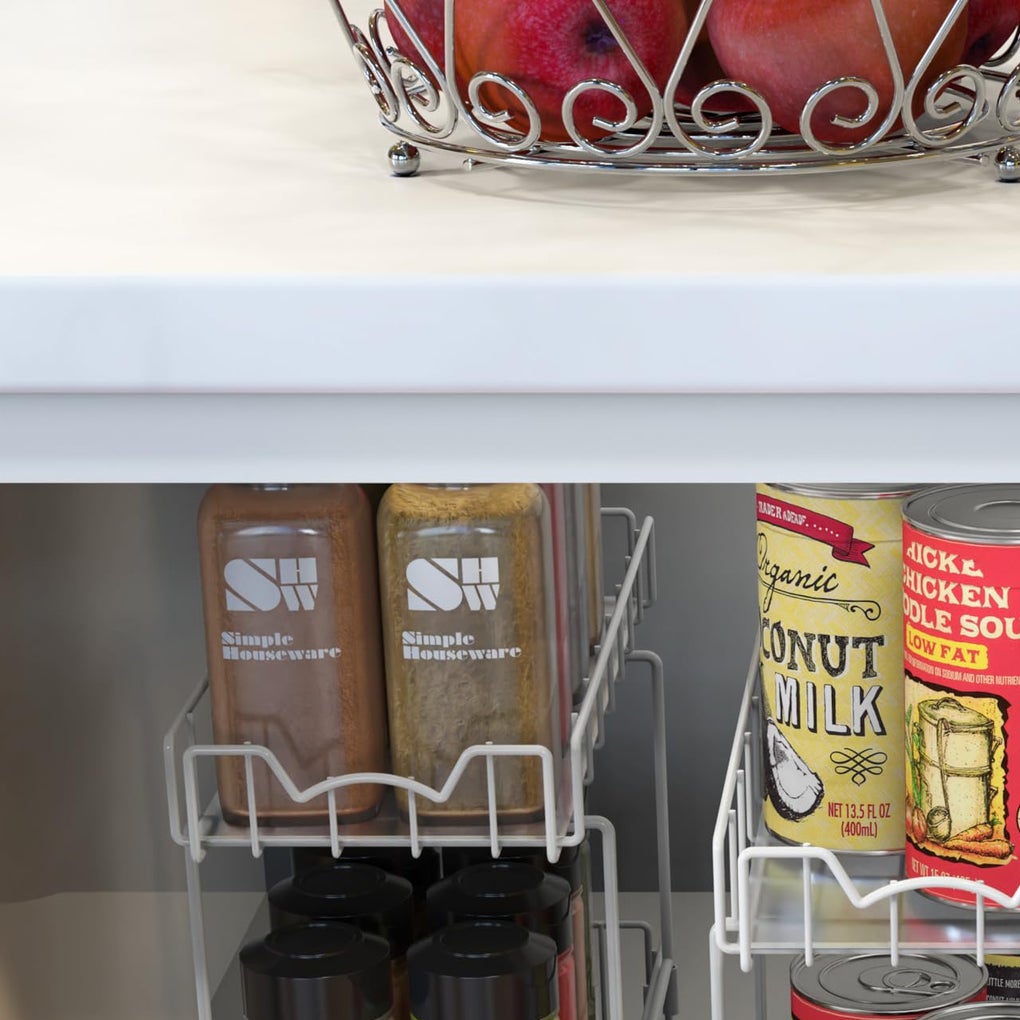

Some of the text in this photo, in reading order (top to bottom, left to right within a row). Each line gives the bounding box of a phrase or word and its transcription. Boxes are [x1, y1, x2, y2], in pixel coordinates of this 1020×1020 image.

[757, 532, 840, 613] Organic
[221, 631, 294, 648] Simple
[402, 630, 475, 648] Simple
[908, 630, 980, 664] LOW FAT
[222, 646, 342, 661] Houseware
[403, 645, 522, 660] Houseware
[775, 671, 887, 737] MILK
[827, 802, 891, 819] NET 13.5 FL OZ
[841, 821, 878, 839] (400mL)
[1005, 979, 1020, 989] MORE
